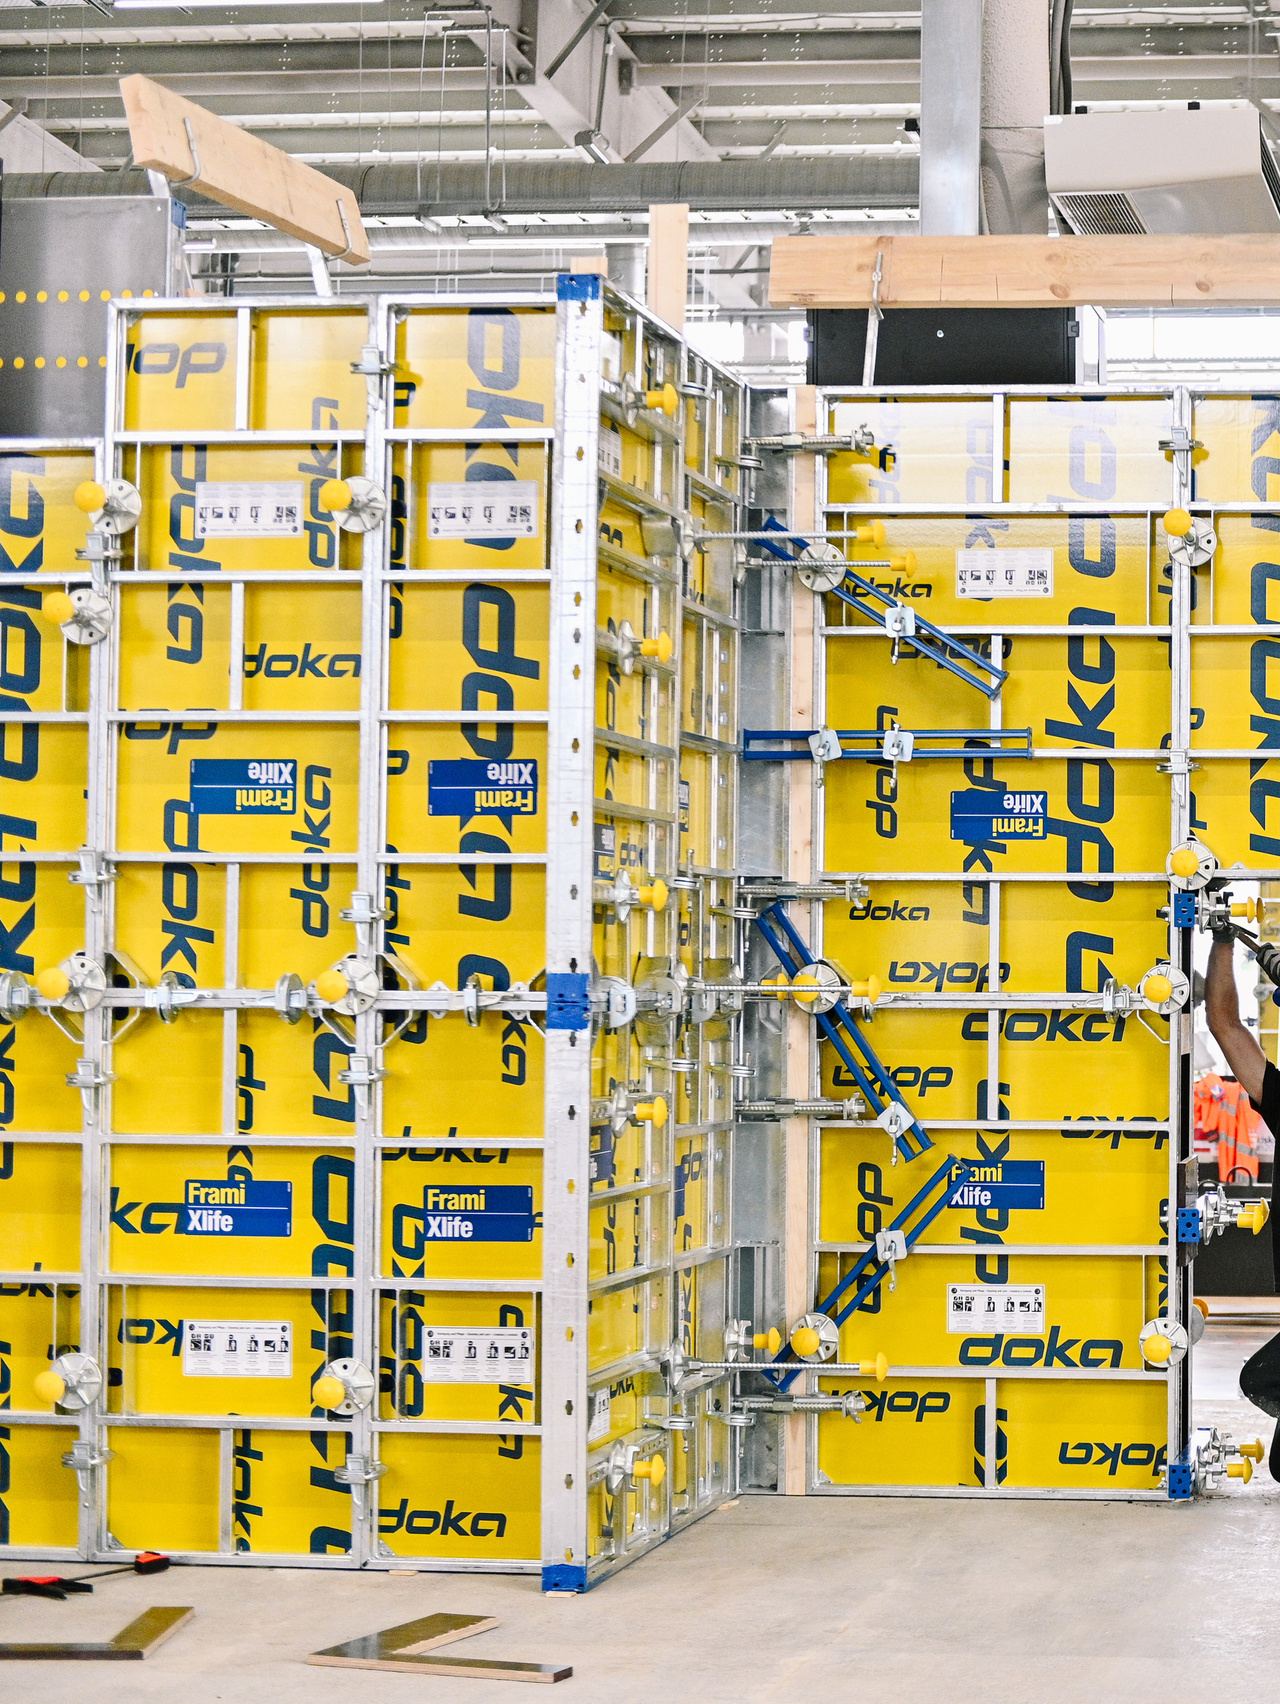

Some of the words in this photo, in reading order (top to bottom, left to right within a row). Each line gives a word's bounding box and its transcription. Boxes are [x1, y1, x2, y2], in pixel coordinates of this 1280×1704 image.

[230, 643, 361, 678] doka
[1045, 606, 1116, 903] doka
[248, 763, 293, 784] Xlife
[487, 764, 533, 784] Xlife
[236, 790, 293, 810] Frami
[475, 791, 533, 812] Frami
[1004, 794, 1043, 813] Xlife
[993, 818, 1043, 836] Frami
[286, 760, 330, 937] doka
[850, 900, 929, 920] doka
[890, 962, 1010, 992] doka
[962, 1009, 1125, 1041] doka
[952, 1164, 1002, 1181] Fami
[189, 1183, 245, 1204] Frami
[428, 1189, 485, 1210] Frami
[952, 1186, 991, 1205] Xlife
[188, 1210, 233, 1231] Xlife
[428, 1217, 473, 1237] Xlife
[960, 1326, 1123, 1367] doka
[370, 1498, 508, 1539] doka
